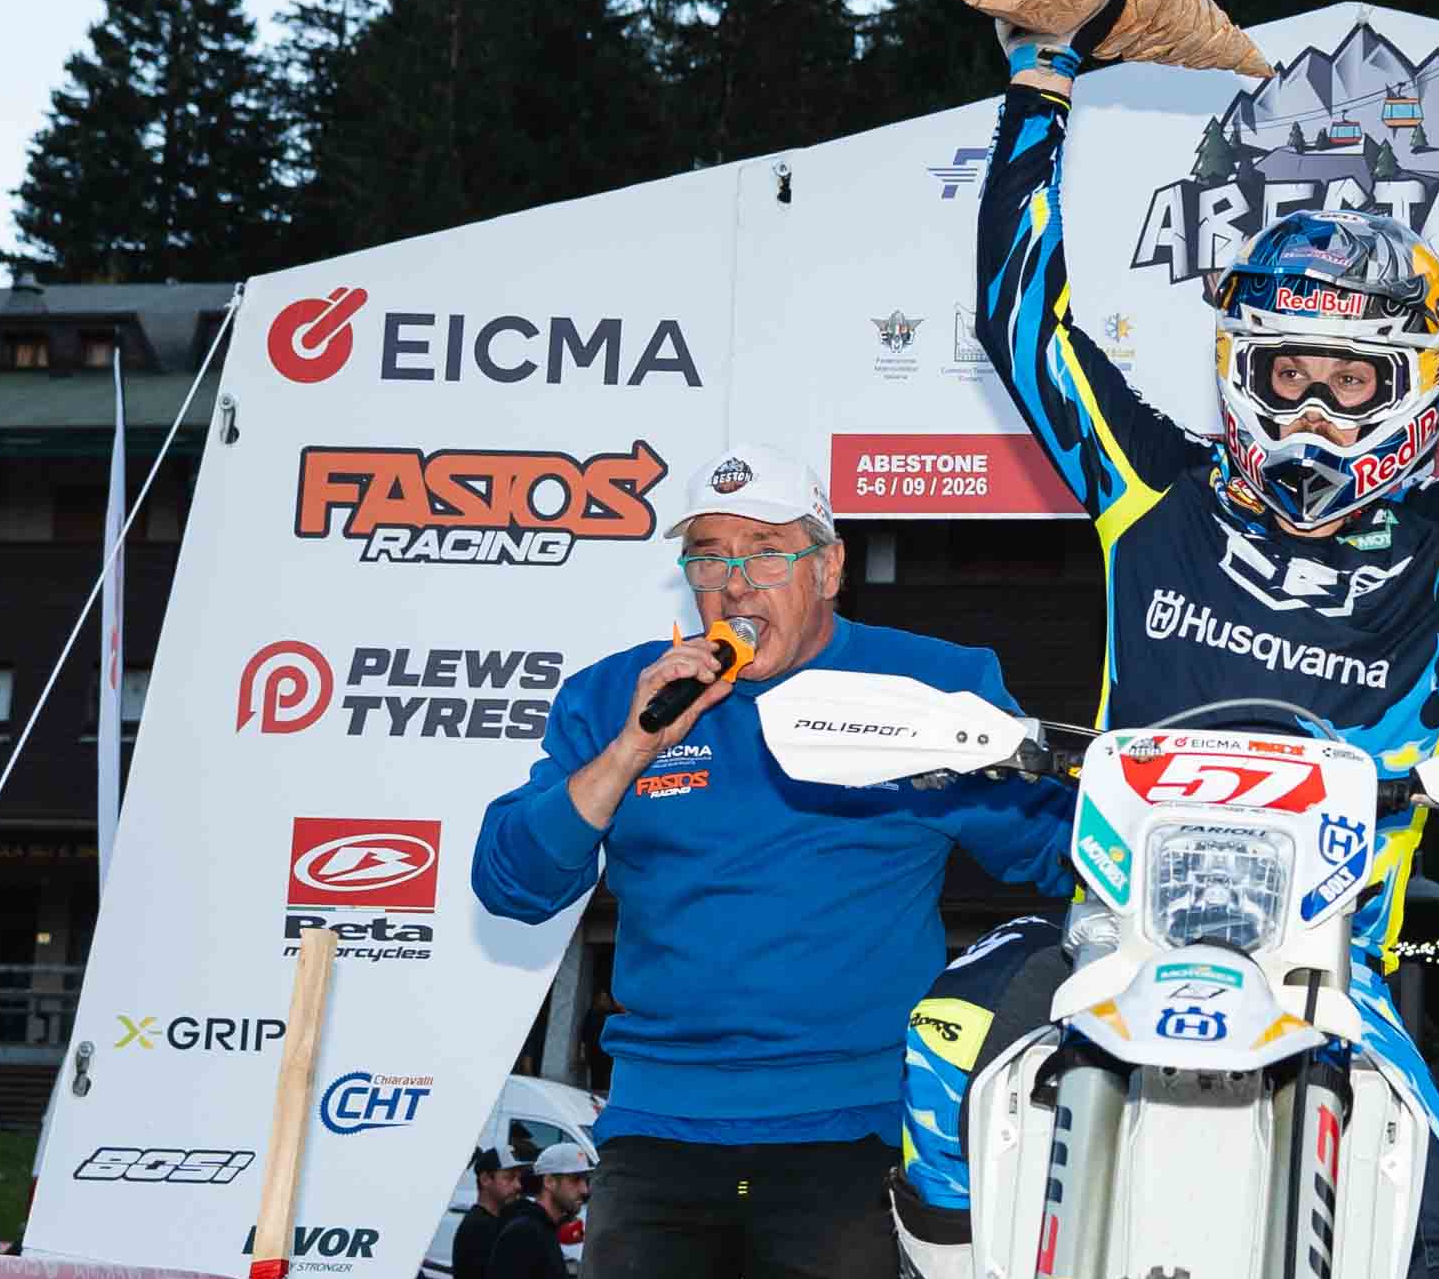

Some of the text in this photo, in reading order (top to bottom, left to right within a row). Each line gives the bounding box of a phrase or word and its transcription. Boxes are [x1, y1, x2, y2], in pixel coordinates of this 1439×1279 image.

[1276, 287, 1364, 316] Red Bull
[381, 312, 703, 388] EICMA
[857, 454, 988, 473] ABESTONE
[1353, 423, 1416, 498] Red
[857, 477, 988, 496] 5-6 / 09 / 2026
[361, 530, 576, 566] RACING
[1178, 603, 1391, 689] Husqvarna
[346, 647, 563, 691] PLEWS
[341, 695, 549, 740] TYRES
[1190, 738, 1241, 750] EICMA
[1147, 753, 1313, 808] 57
[1180, 824, 1266, 837] FARIOLI
[1317, 869, 1357, 904] BOLT
[283, 914, 434, 943] Beta
[283, 945, 431, 962] morcycles
[373, 1074, 434, 1086] Chiaravalli
[336, 1087, 431, 1121] CHT
[296, 1262, 353, 1273] STRONGER
